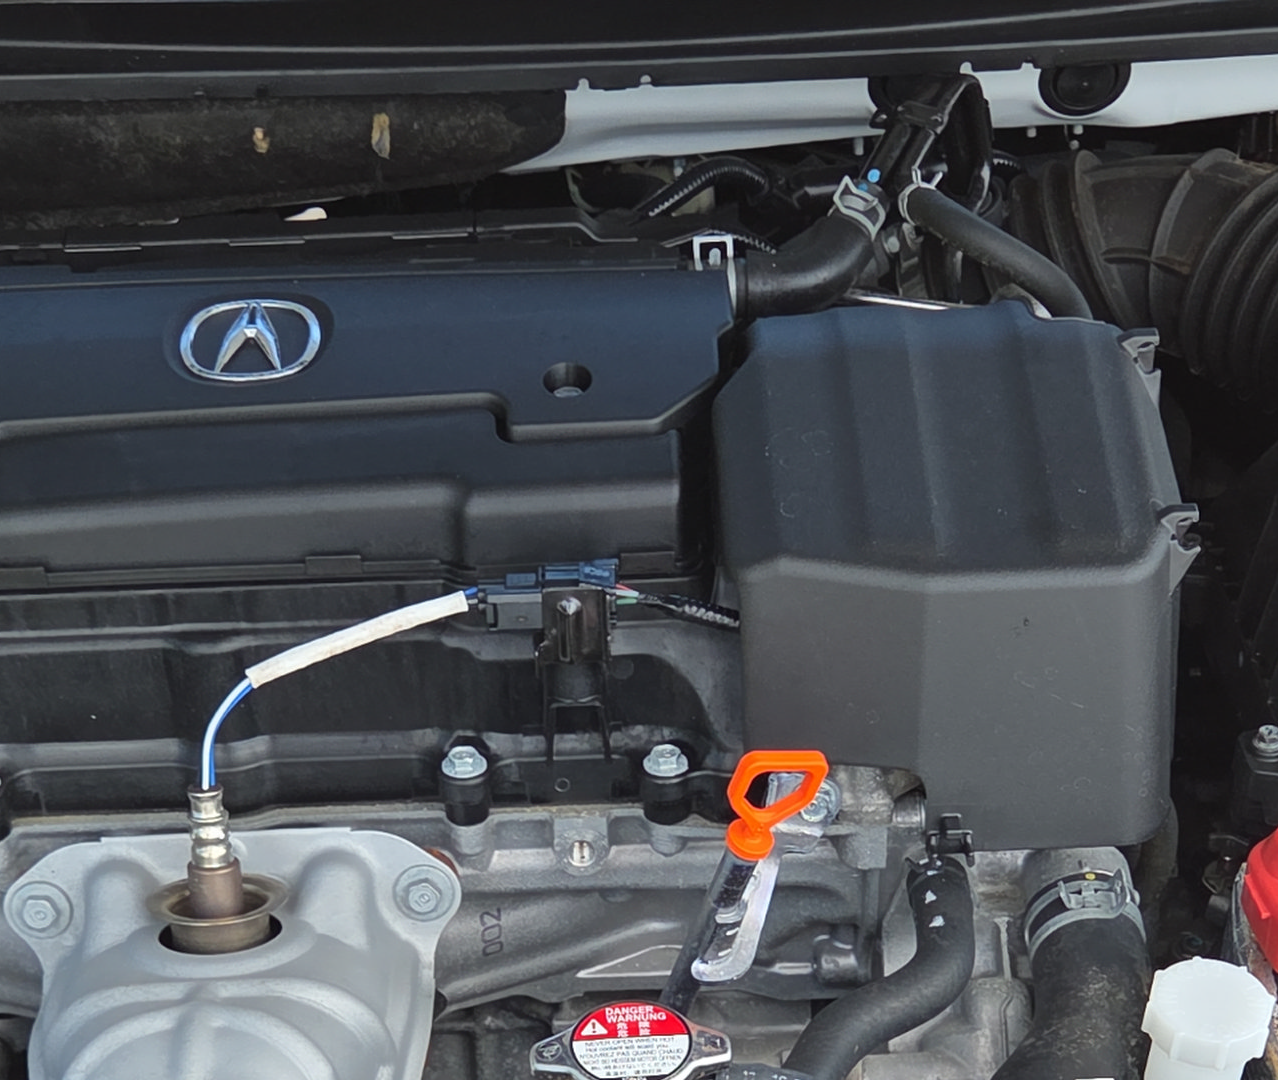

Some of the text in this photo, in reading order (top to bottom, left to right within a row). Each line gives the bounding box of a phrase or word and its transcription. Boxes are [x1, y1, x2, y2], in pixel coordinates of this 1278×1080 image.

[482, 907, 501, 958] 002
[605, 1005, 654, 1016] DANGER
[606, 1012, 667, 1024] WARNUNG
